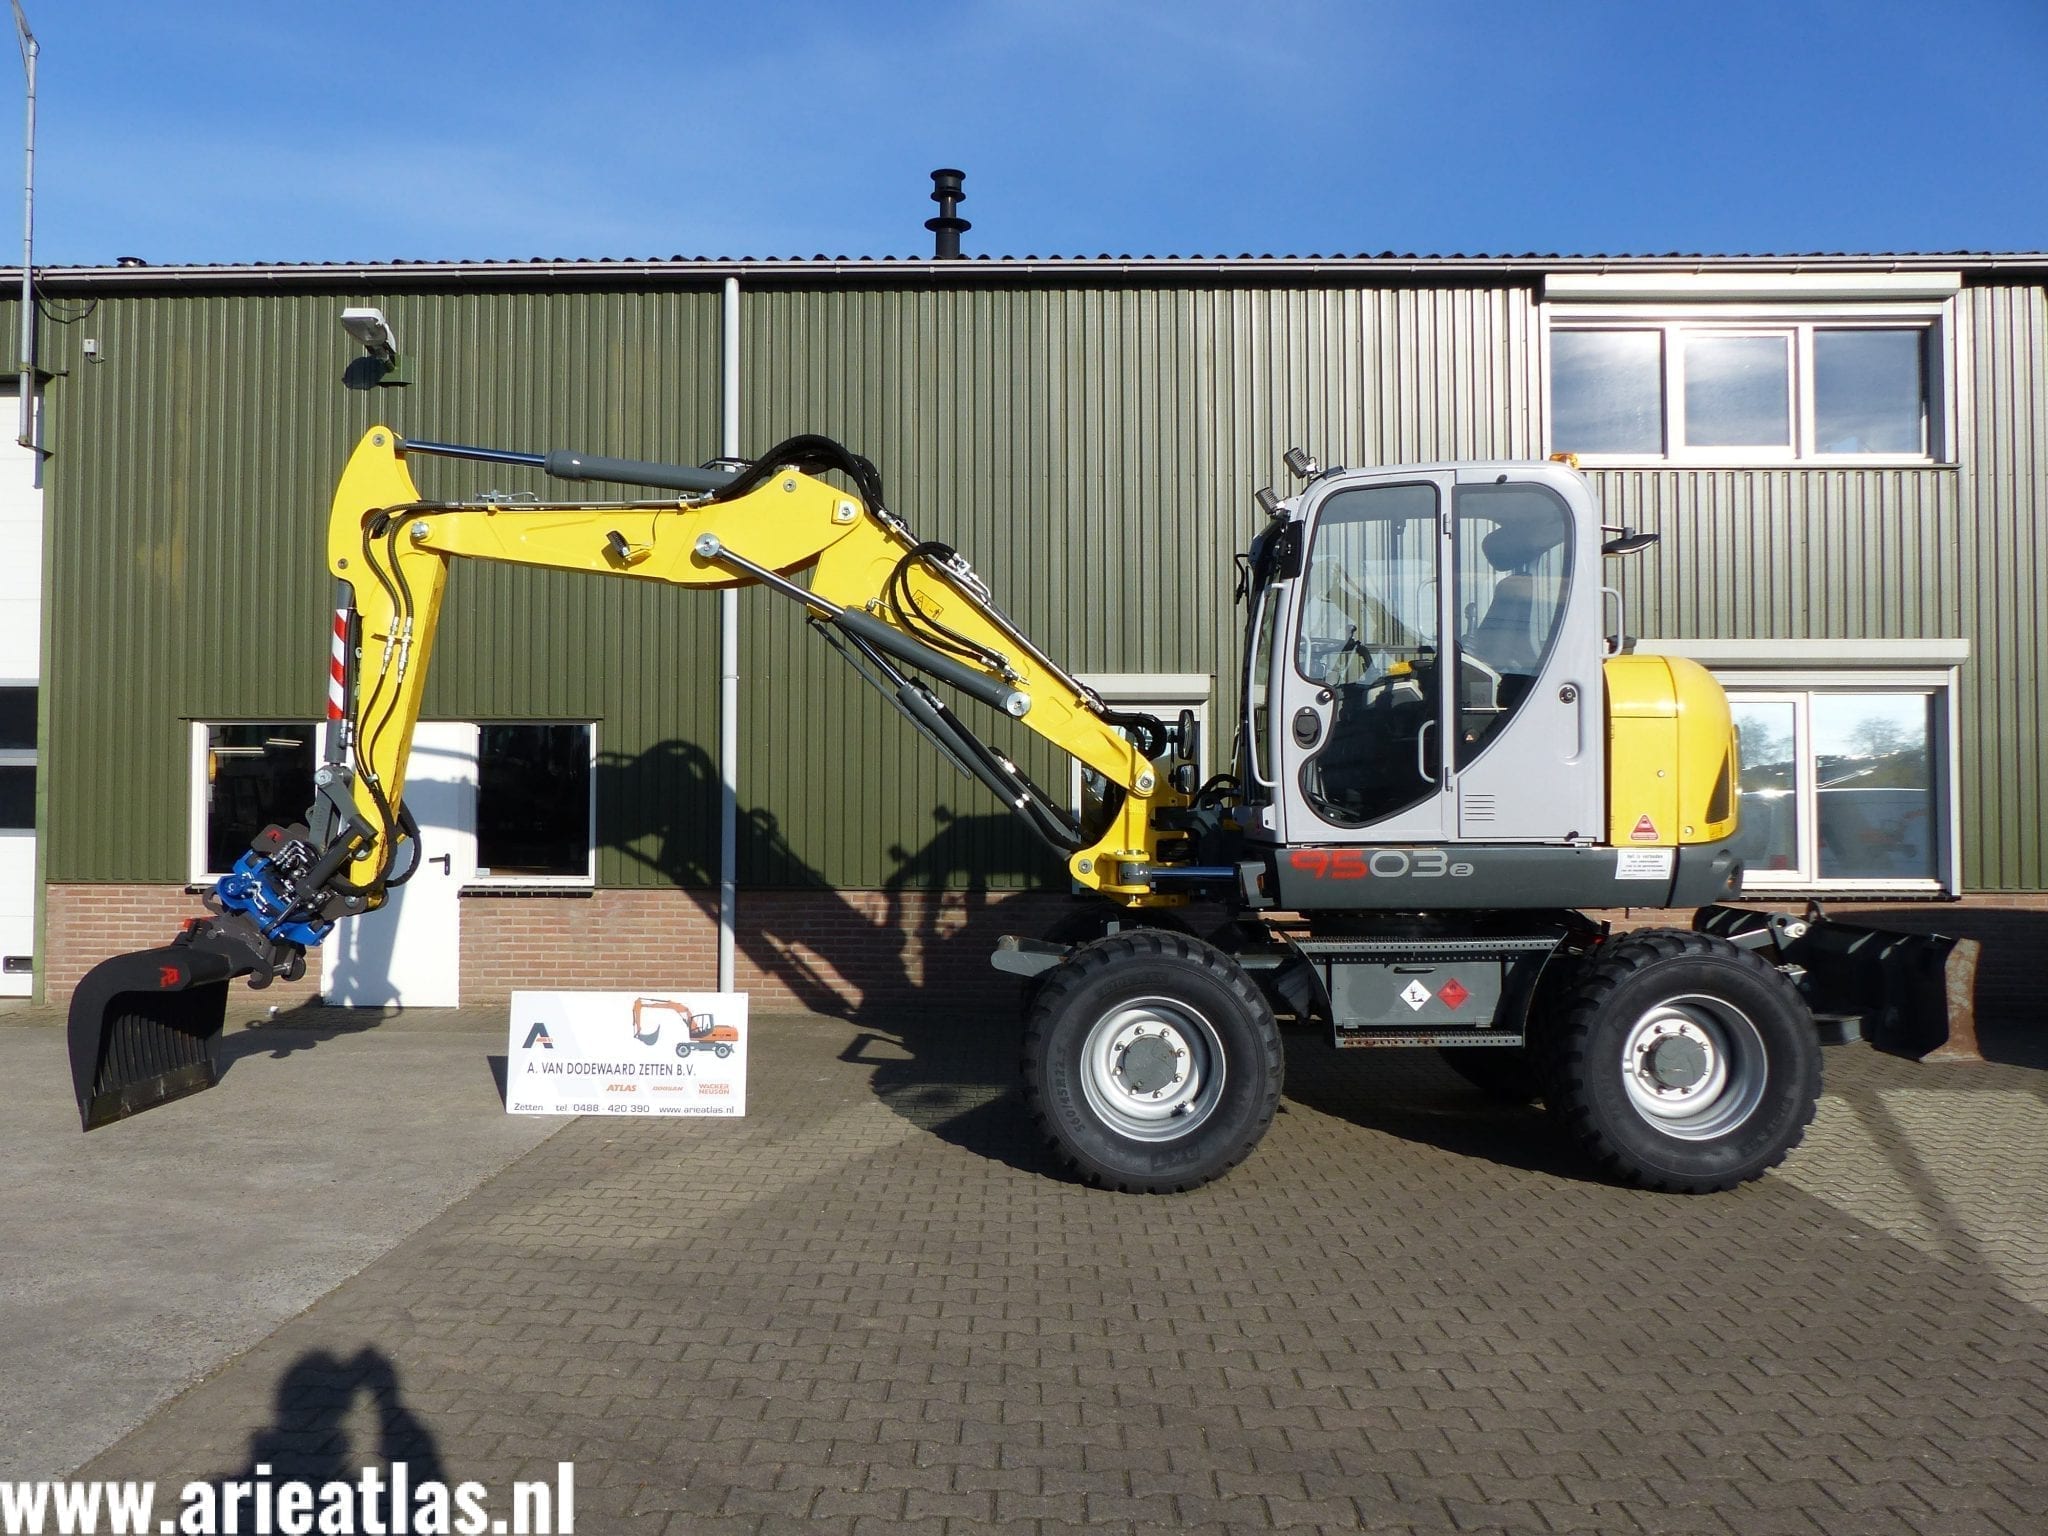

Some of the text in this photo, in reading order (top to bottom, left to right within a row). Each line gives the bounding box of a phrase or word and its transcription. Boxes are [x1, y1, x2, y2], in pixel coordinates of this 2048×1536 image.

[527, 1062, 697, 1077] A. VAN DODEWAARD ZETTEN B.V.
[606, 1084, 637, 1092] ATLAS
[514, 1102, 544, 1111] Zetten
[573, 1103, 599, 1112] 0488
[607, 1104, 628, 1113] 420
[630, 1104, 650, 1113] 390
